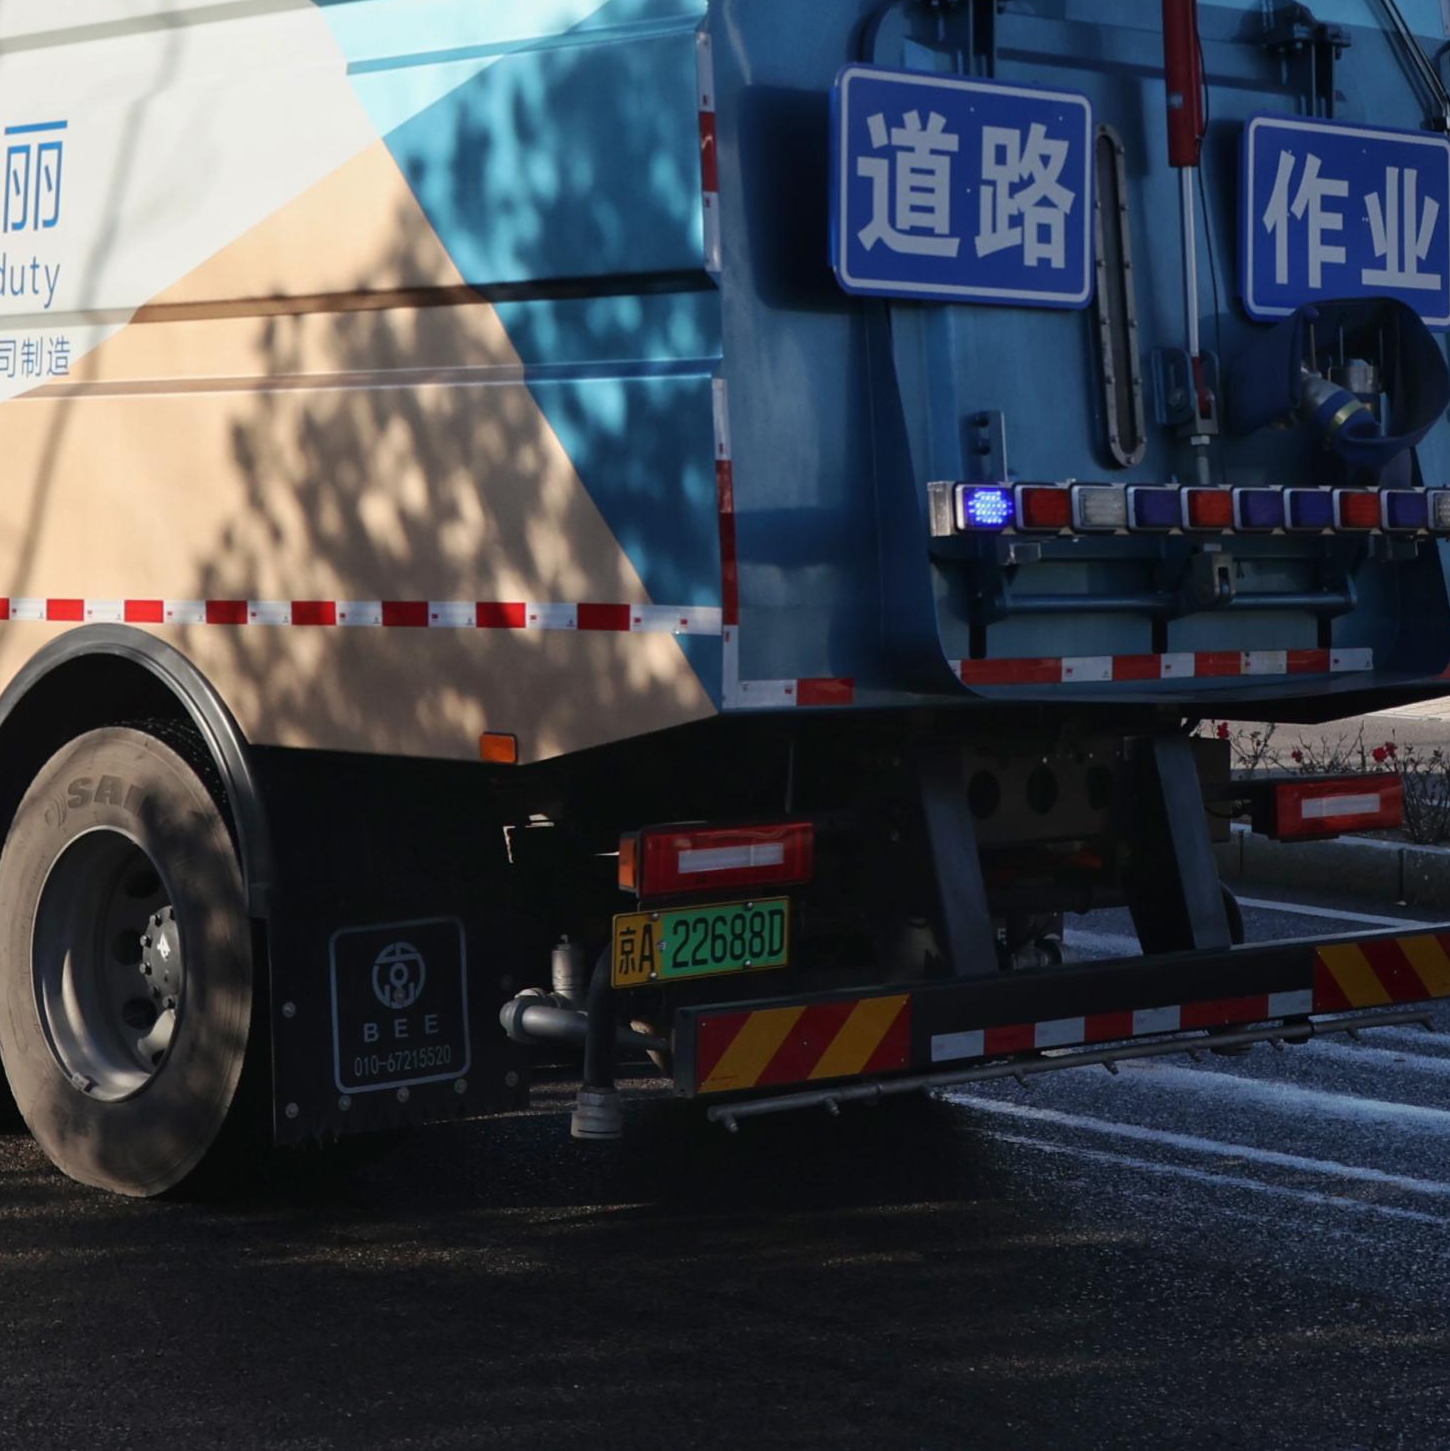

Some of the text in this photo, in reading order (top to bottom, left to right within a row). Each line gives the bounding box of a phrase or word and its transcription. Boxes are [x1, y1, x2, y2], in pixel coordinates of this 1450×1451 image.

[856, 108, 1076, 270] 道路
[1262, 148, 1443, 291] 作业
[363, 1013, 438, 1043] BEE
